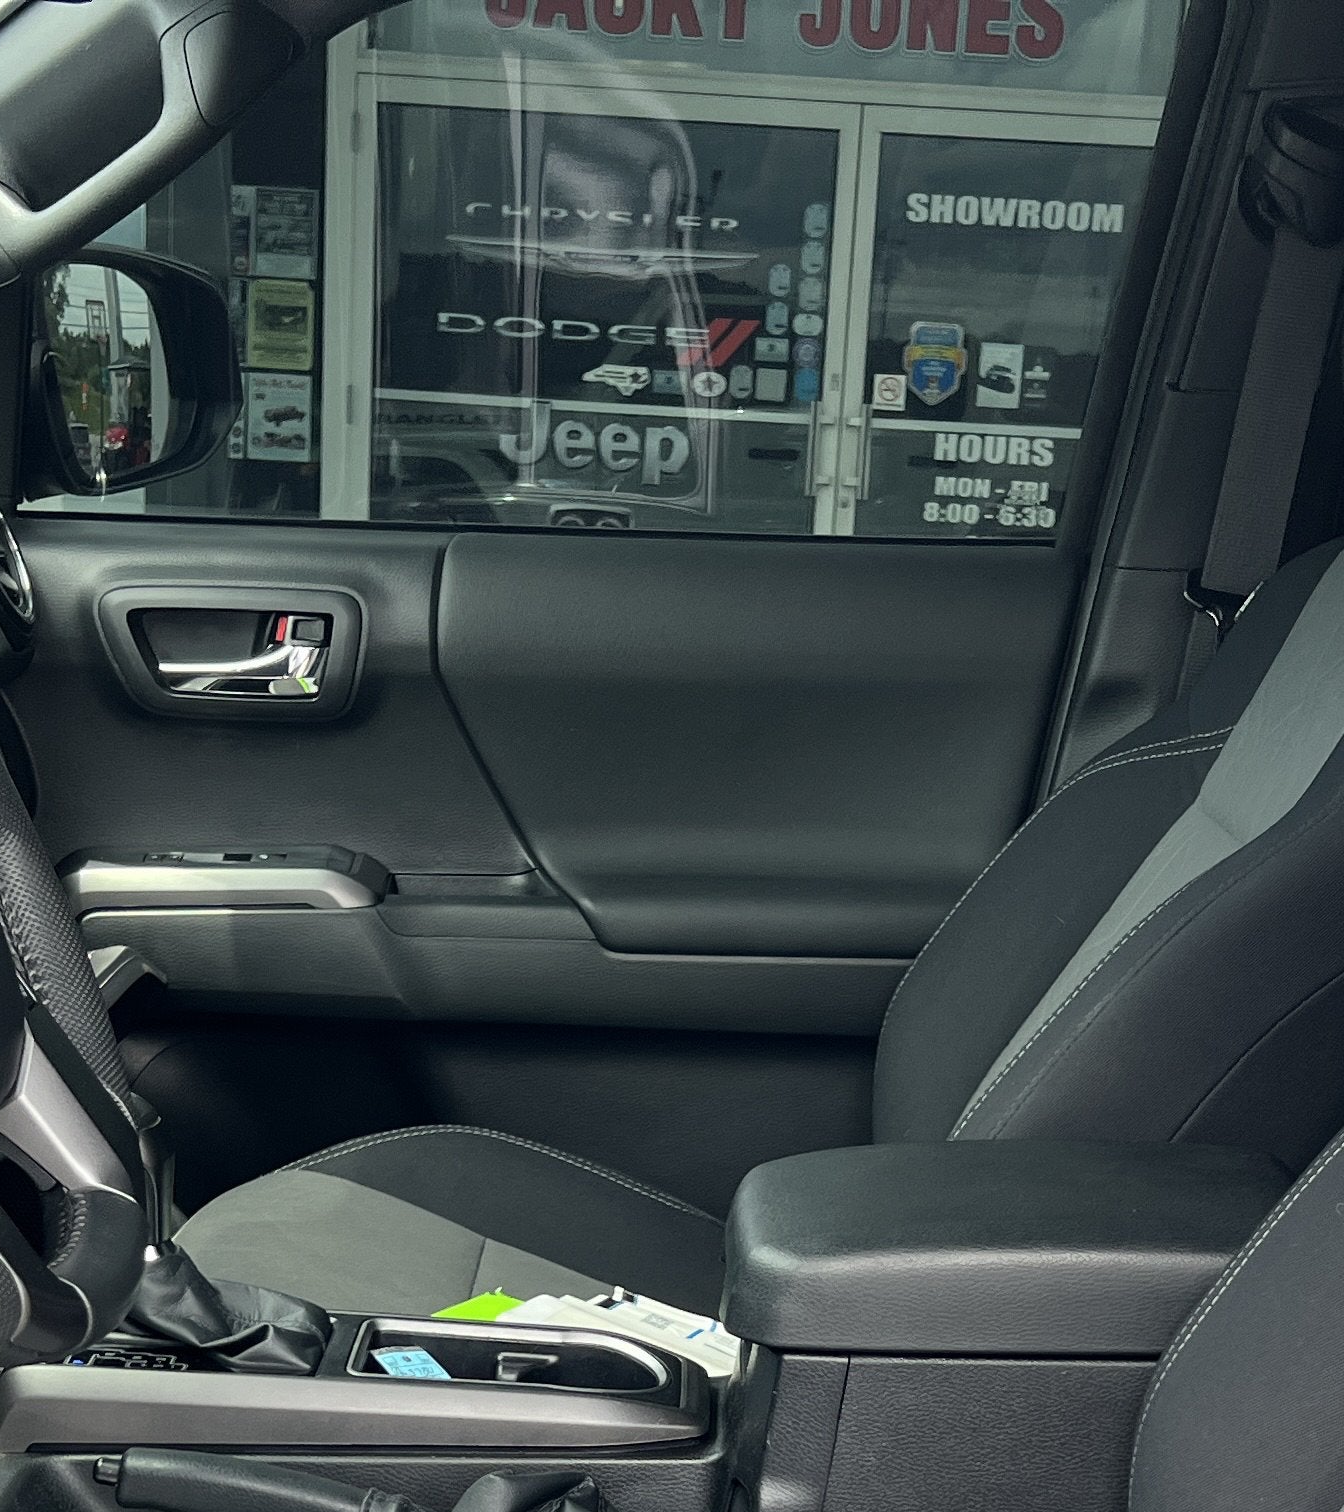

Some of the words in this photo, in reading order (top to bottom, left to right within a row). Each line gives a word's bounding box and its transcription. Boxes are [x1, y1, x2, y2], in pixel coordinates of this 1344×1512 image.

[906, 192, 1125, 233] SHOWROOM
[436, 312, 710, 348] DODGE
[499, 401, 690, 486] Jeep
[933, 433, 1055, 467] HOURS
[934, 476, 992, 499] MON
[923, 502, 981, 525] 8:00
